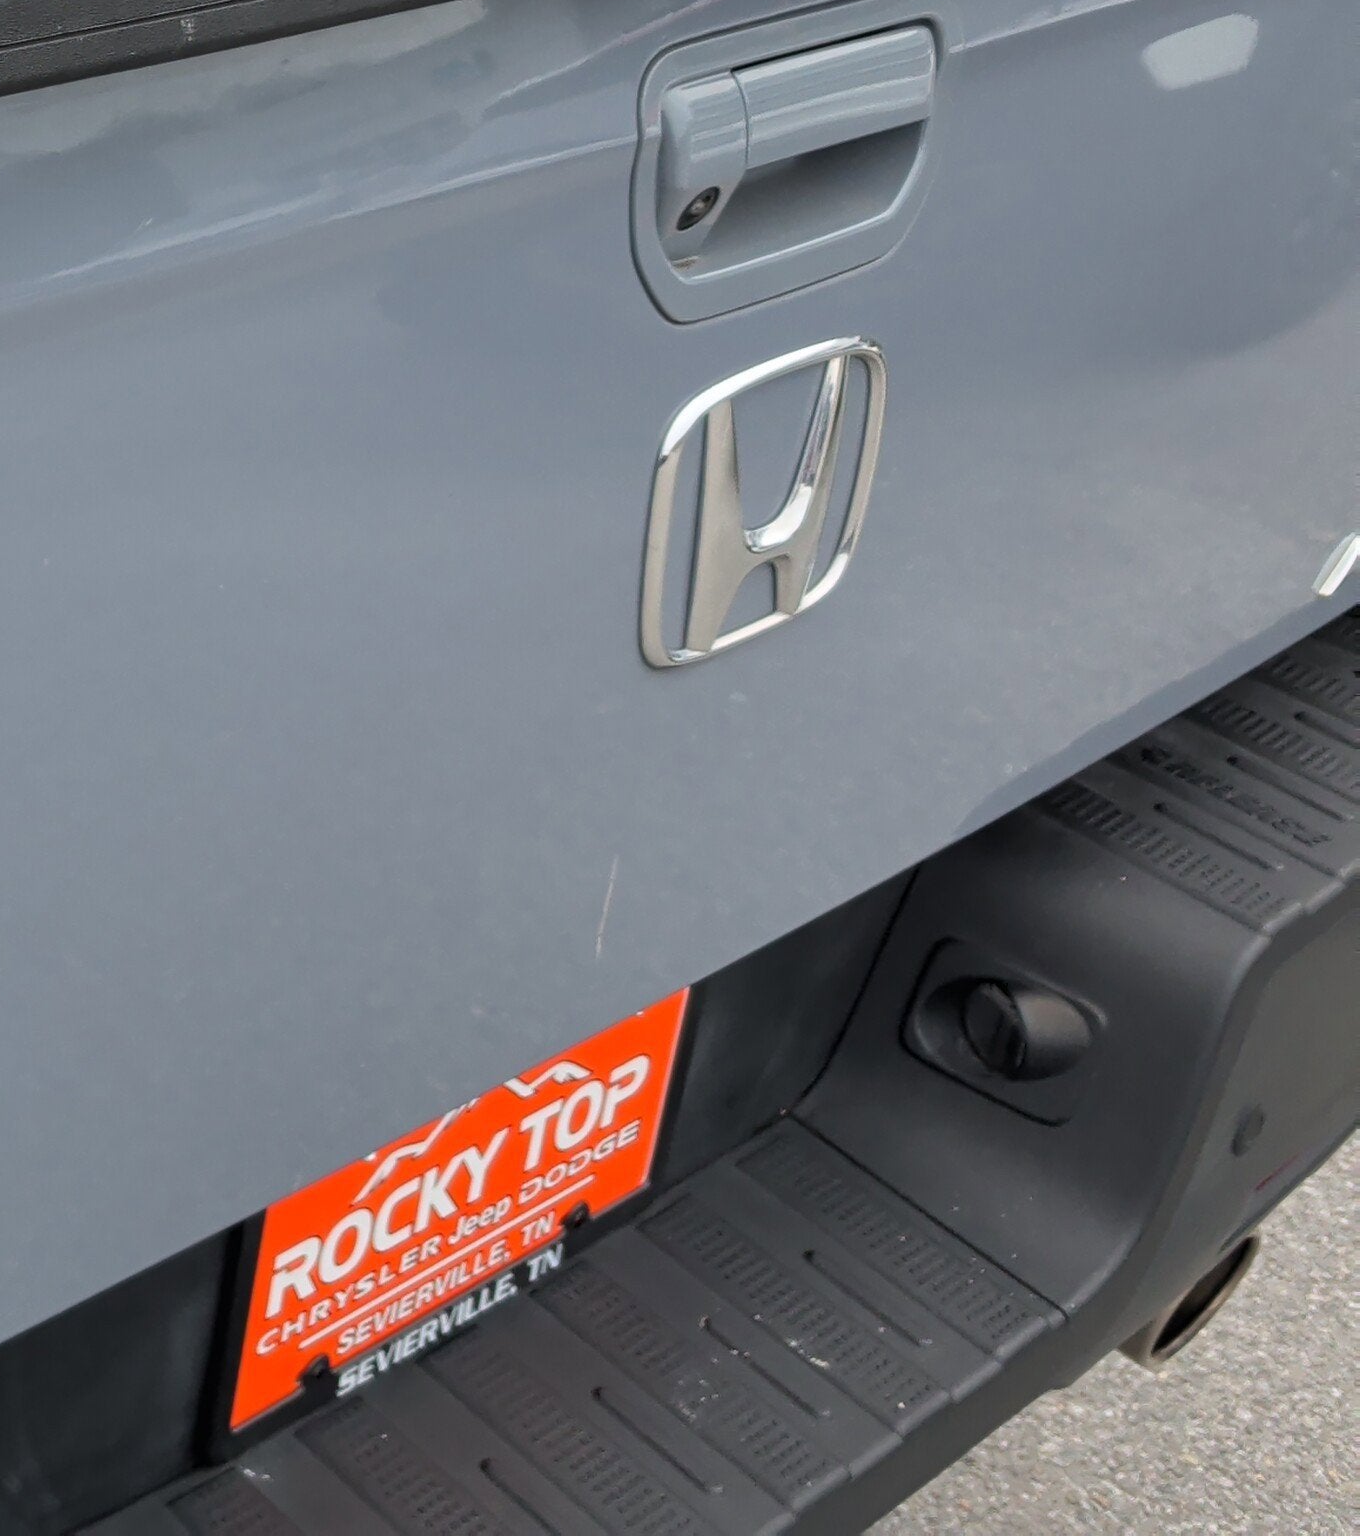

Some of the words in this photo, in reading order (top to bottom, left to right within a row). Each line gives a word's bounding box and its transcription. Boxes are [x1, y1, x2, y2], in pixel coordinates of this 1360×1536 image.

[255, 1233, 443, 1356] CHRYSLER
[448, 1195, 513, 1244] Jeep
[518, 1117, 642, 1204] DODGE
[264, 1125, 511, 1319] ROCKY
[520, 1054, 650, 1172] TOP
[527, 1242, 564, 1282] TN
[336, 1239, 511, 1354] SEVIERVILLE,
[521, 1211, 556, 1247] TN
